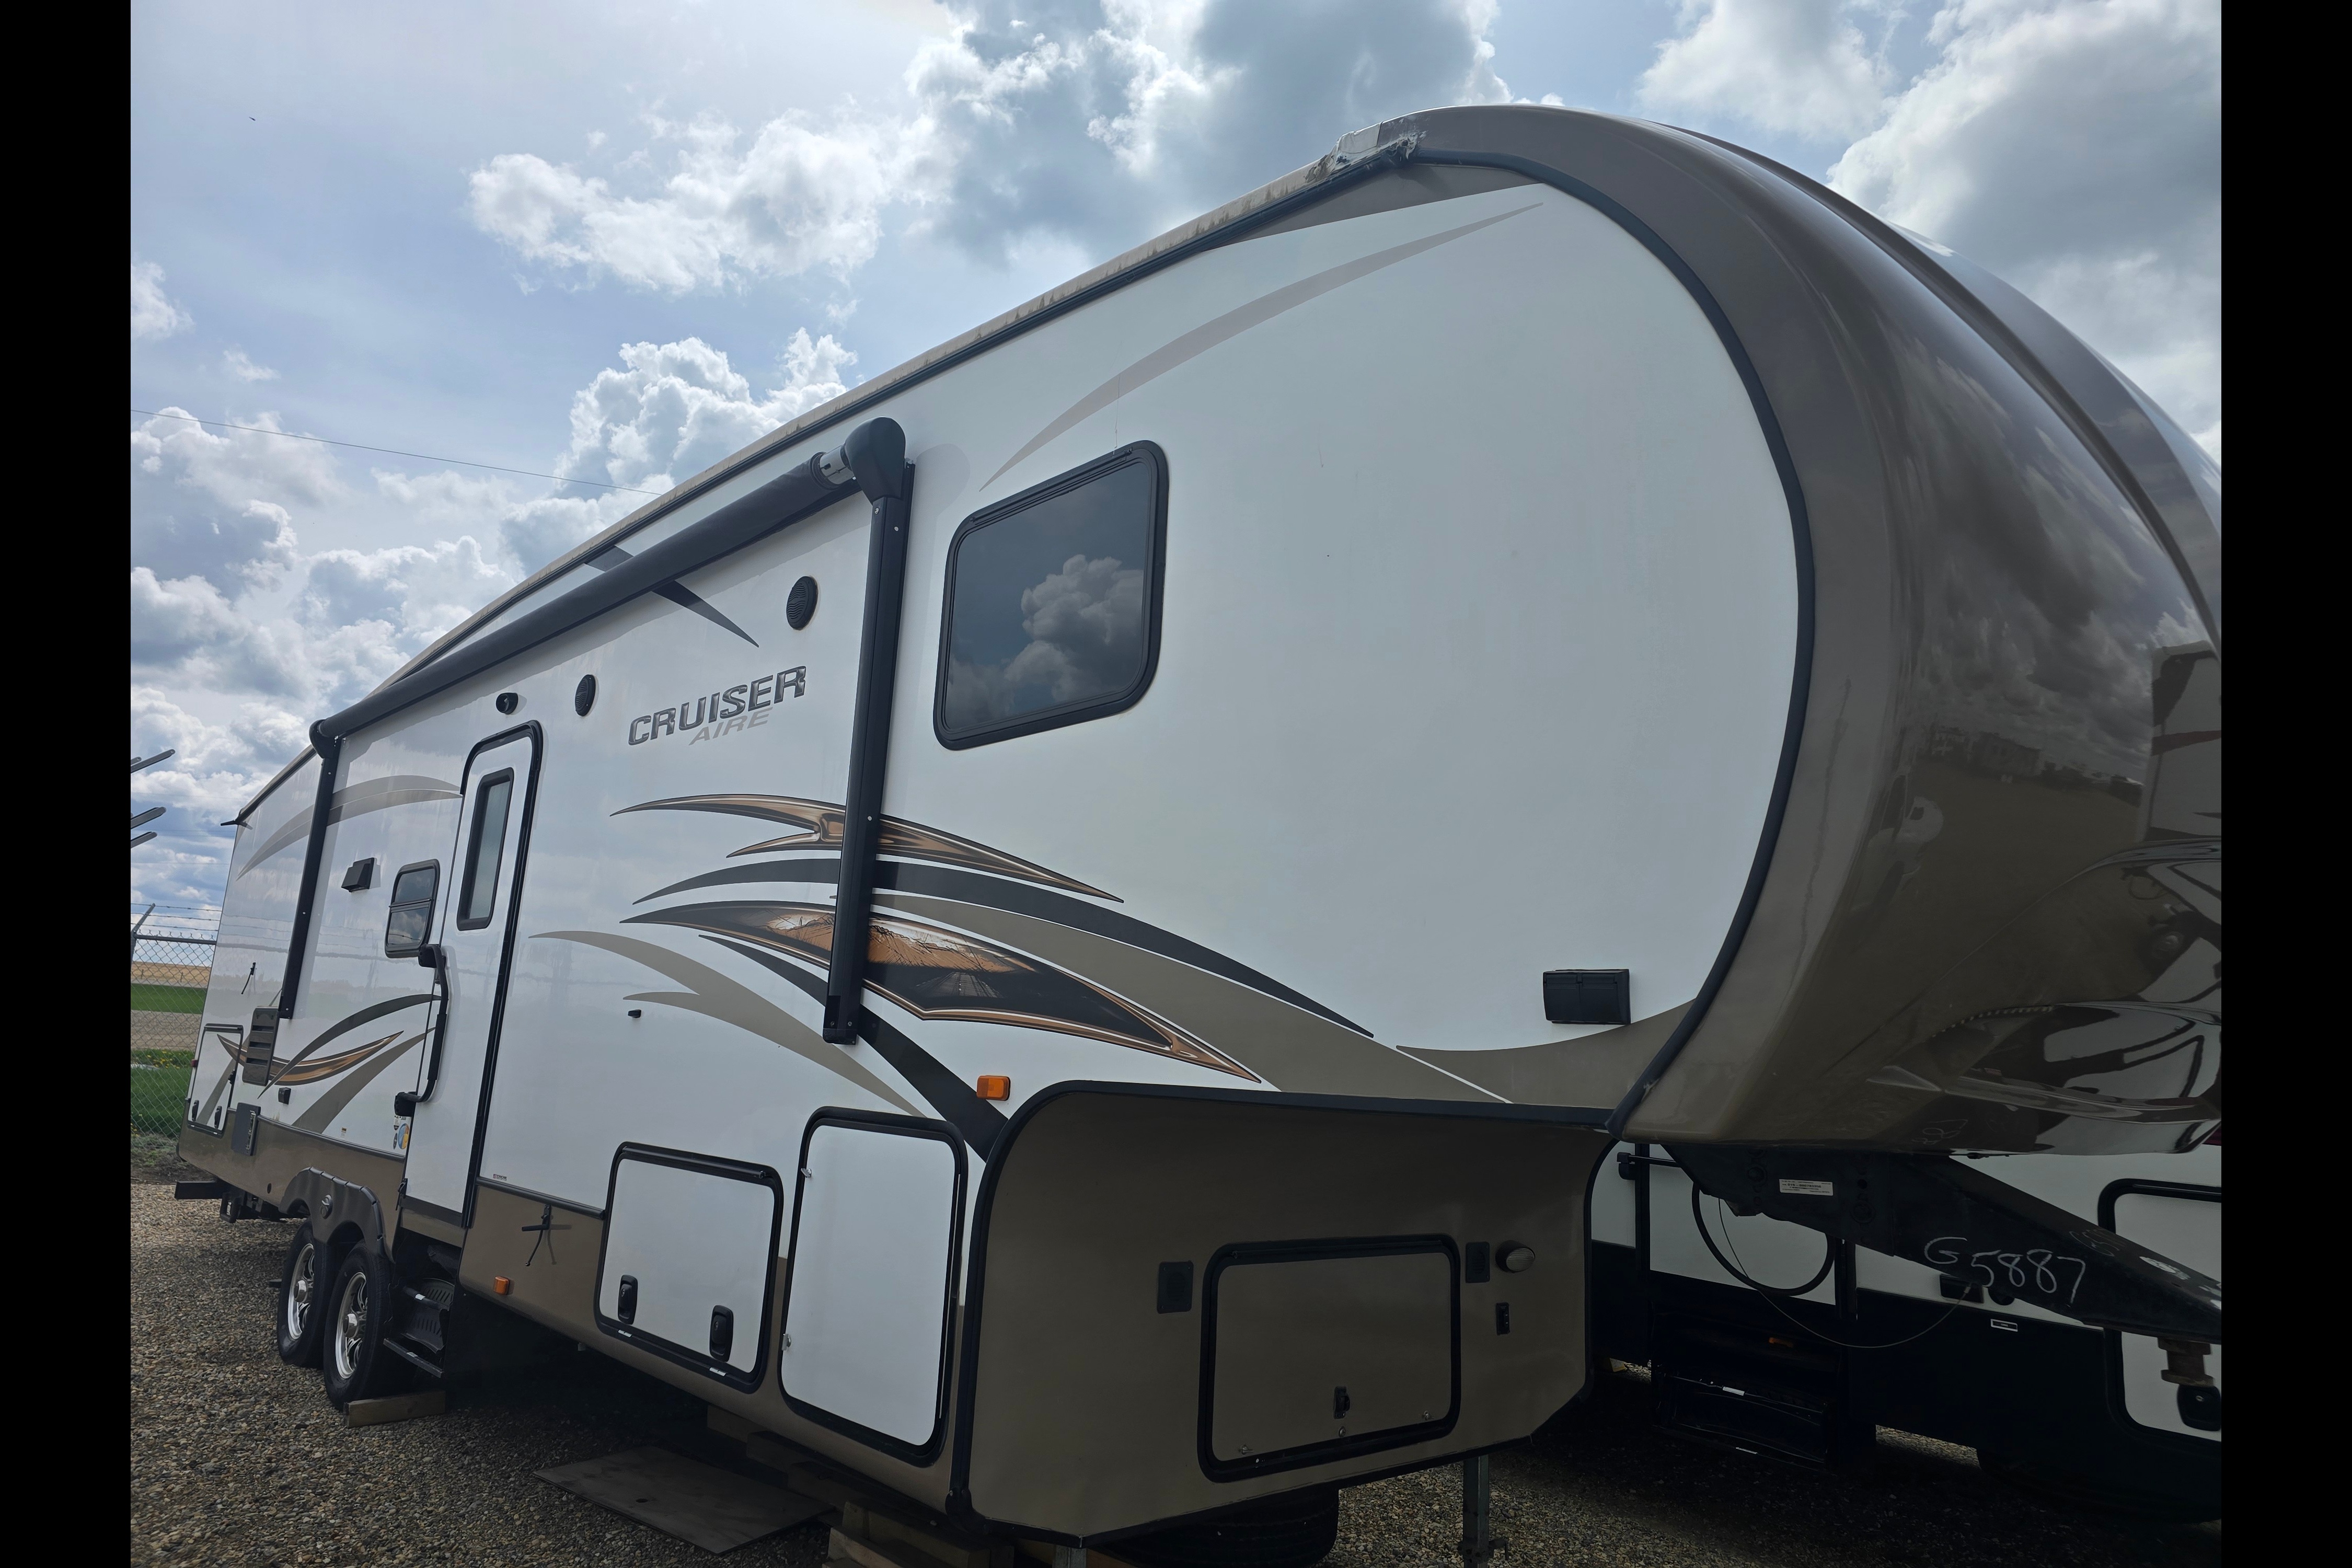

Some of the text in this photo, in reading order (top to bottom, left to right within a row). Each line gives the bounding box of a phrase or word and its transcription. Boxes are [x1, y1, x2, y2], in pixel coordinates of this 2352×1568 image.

[628, 665, 806, 746] CRUISER
[688, 707, 774, 746] AIRE
[1924, 1236, 2086, 1307] G5887
